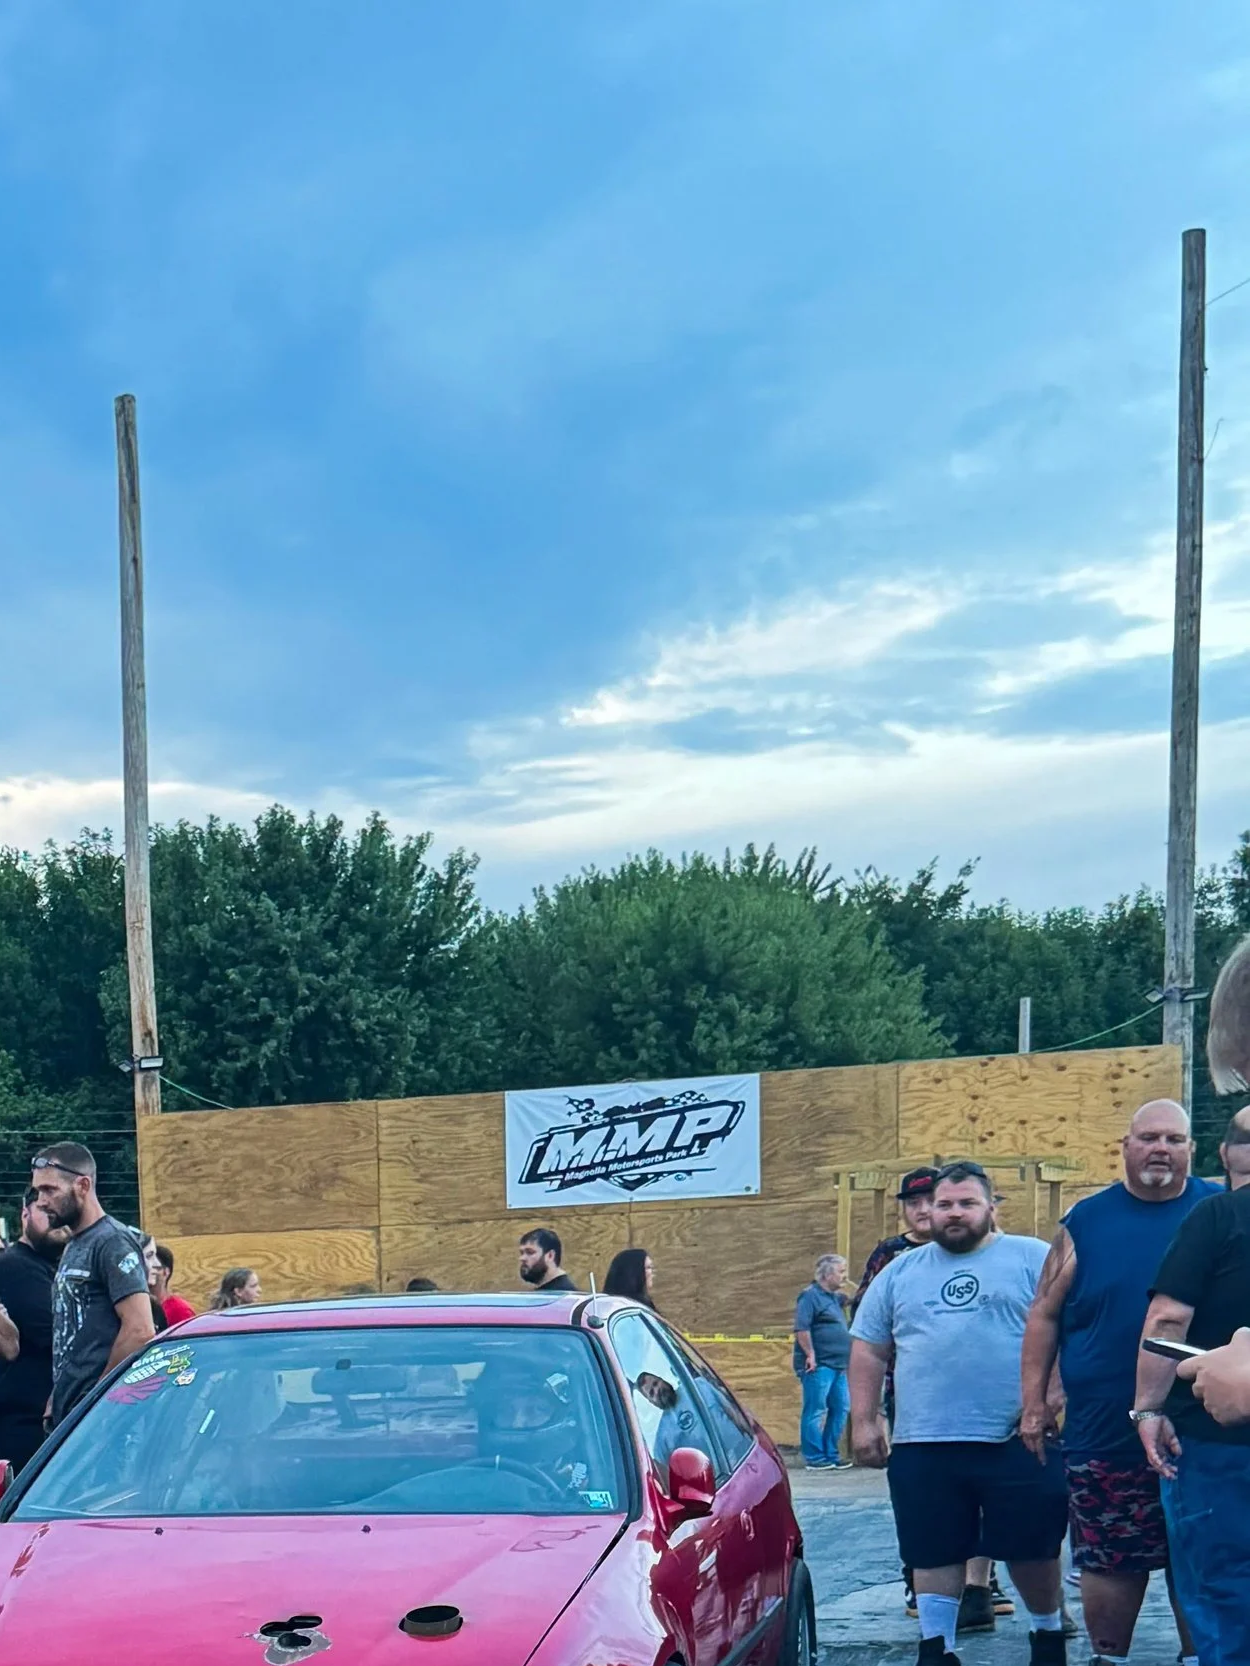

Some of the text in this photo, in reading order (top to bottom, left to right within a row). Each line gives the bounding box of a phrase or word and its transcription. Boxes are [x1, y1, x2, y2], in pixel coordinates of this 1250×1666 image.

[537, 1106, 734, 1175] MMP
[564, 1149, 687, 1182] Magnolia Motorsports Park
[947, 1281, 974, 1299] USS
